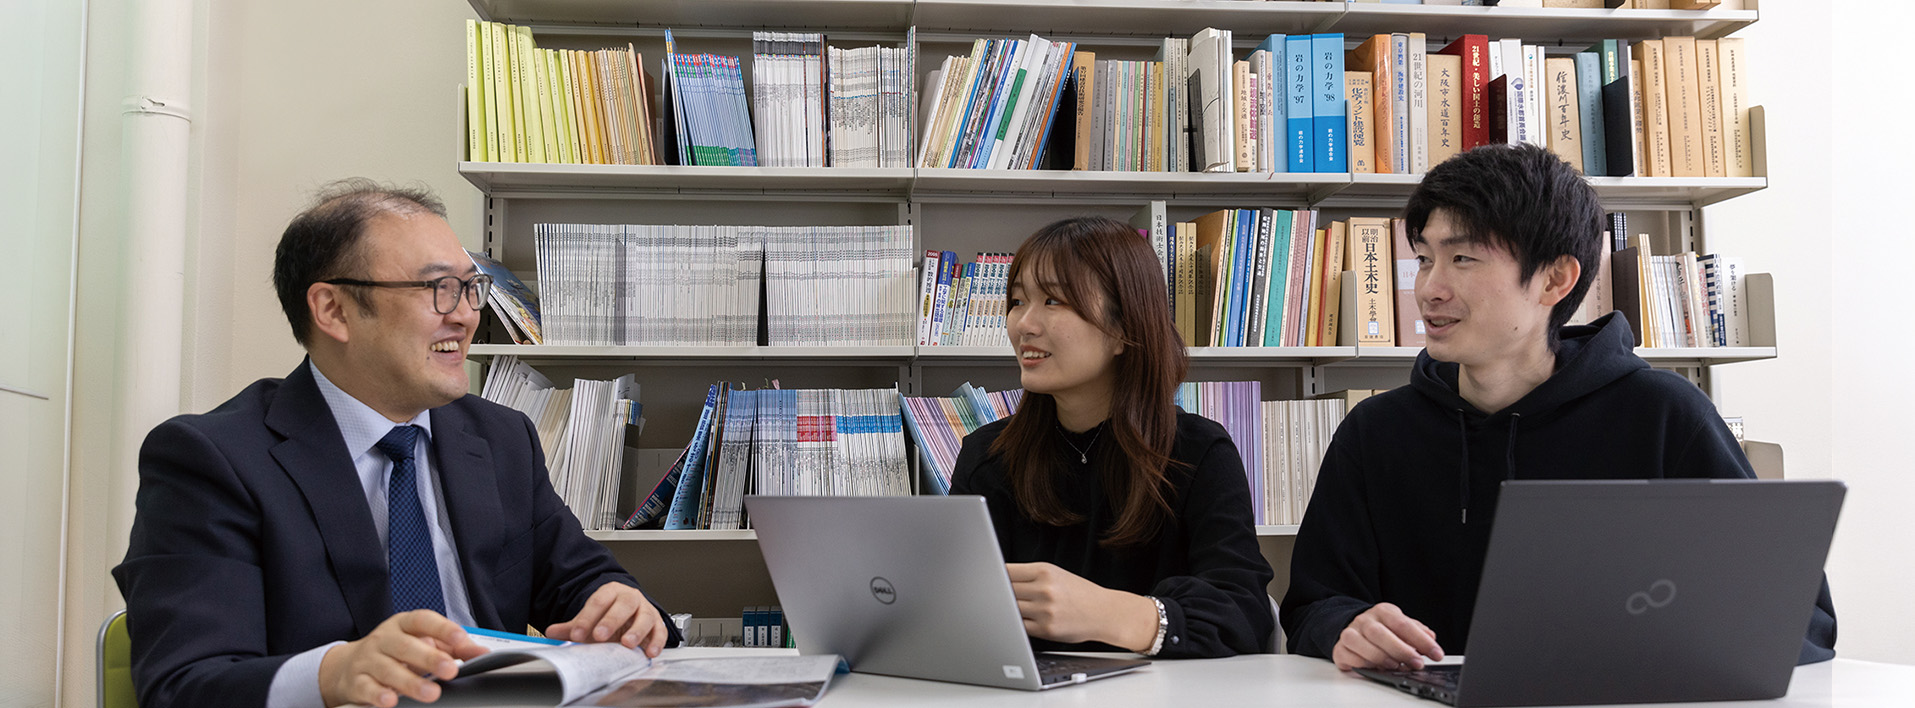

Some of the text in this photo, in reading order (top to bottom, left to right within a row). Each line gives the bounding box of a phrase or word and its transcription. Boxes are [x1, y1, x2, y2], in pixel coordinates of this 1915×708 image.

[1412, 53, 1423, 108] 21世紀の河川
[1440, 68, 1450, 147] 大阪市水道百年史
[1556, 71, 1572, 141] 信濃川百年史
[1363, 243, 1379, 295] 日本土木史
[873, 586, 894, 595] DELL
